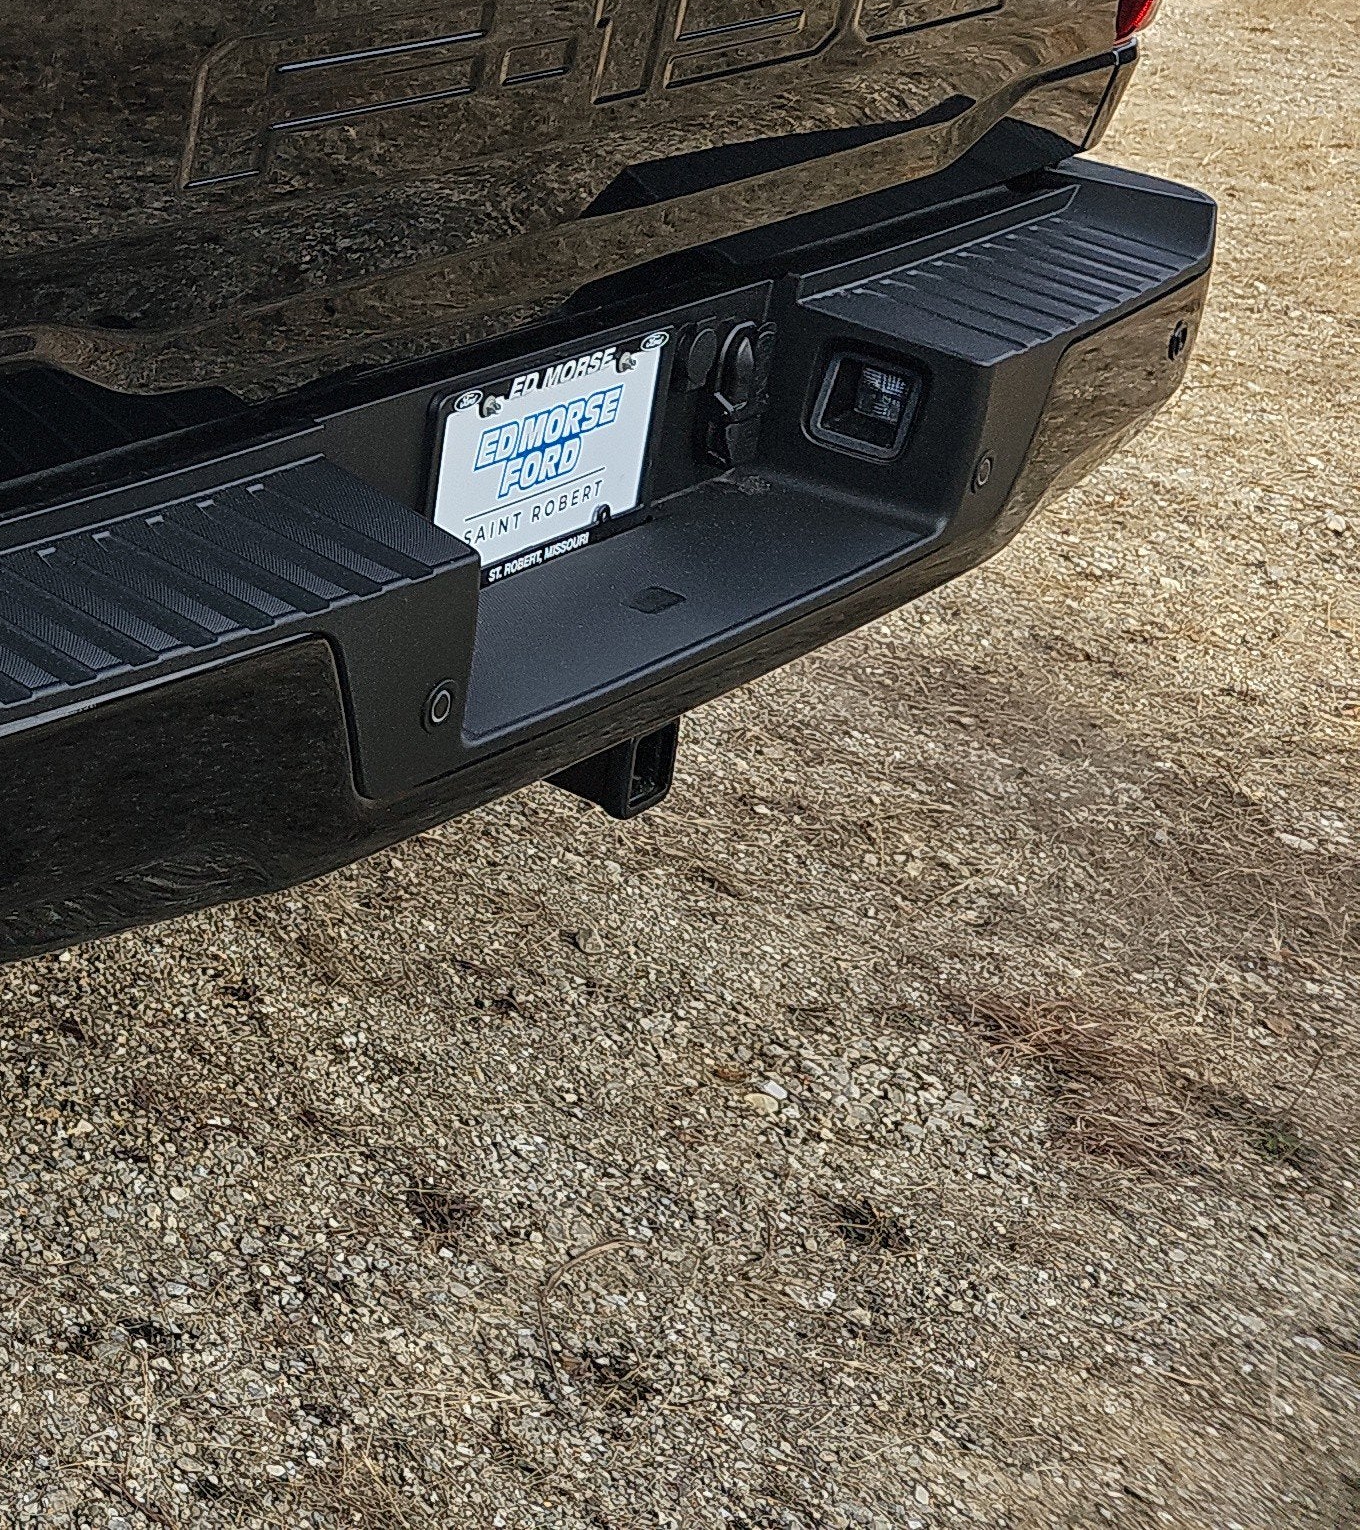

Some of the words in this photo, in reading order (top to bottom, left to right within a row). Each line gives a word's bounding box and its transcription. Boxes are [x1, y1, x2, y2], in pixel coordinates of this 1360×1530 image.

[508, 371, 540, 400] ED
[541, 346, 617, 391] MORSE
[497, 436, 582, 500] FORD
[464, 511, 522, 545] SAINT
[531, 479, 603, 523] ROBERT
[503, 549, 543, 576] ROBERT,
[544, 531, 590, 561] MISSOURI
